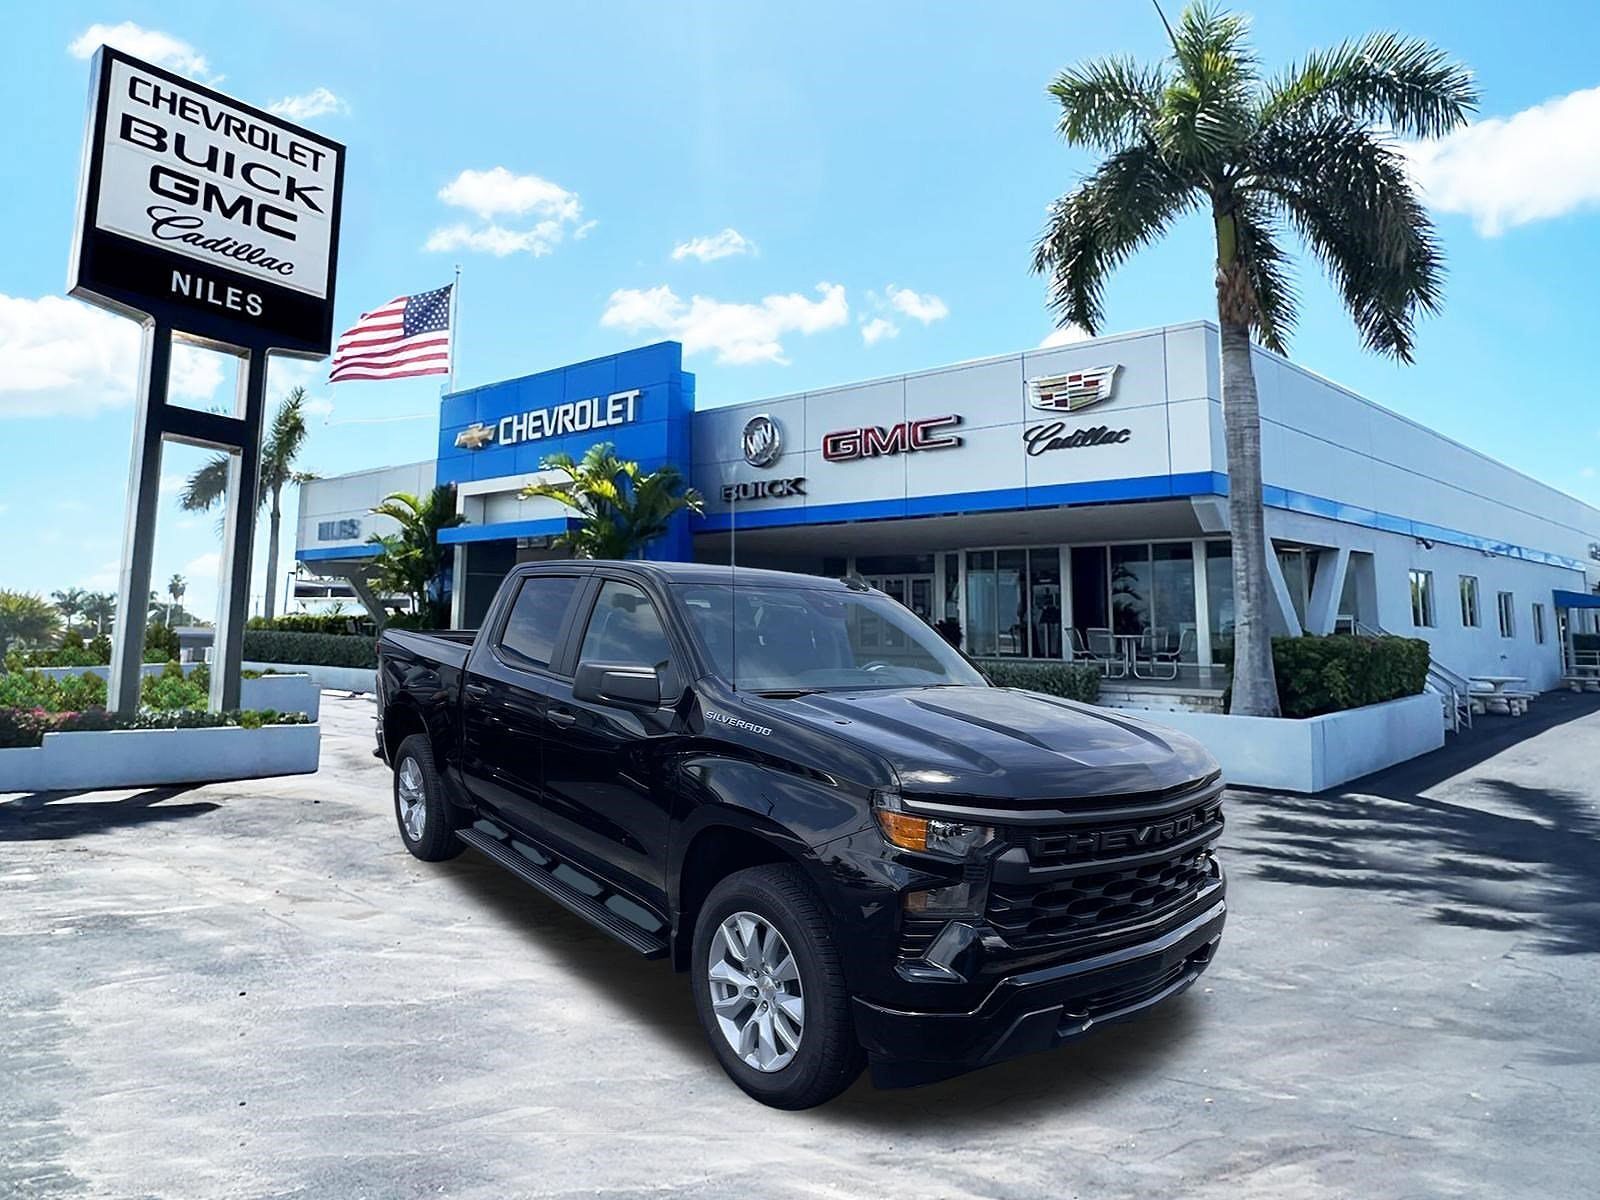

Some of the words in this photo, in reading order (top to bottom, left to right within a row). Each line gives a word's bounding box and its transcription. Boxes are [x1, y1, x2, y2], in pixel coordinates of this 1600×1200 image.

[129, 76, 326, 172] CHEVROLET
[120, 113, 324, 214] BUICK
[150, 164, 298, 241] GMC
[146, 205, 294, 276] Cadillac
[171, 270, 263, 316] NILES
[498, 389, 640, 445] CHEVROLET
[822, 413, 963, 462] GMC
[1022, 421, 1132, 456] Cadillac
[720, 477, 807, 502] BUICK
[704, 711, 772, 736] SILVERADO
